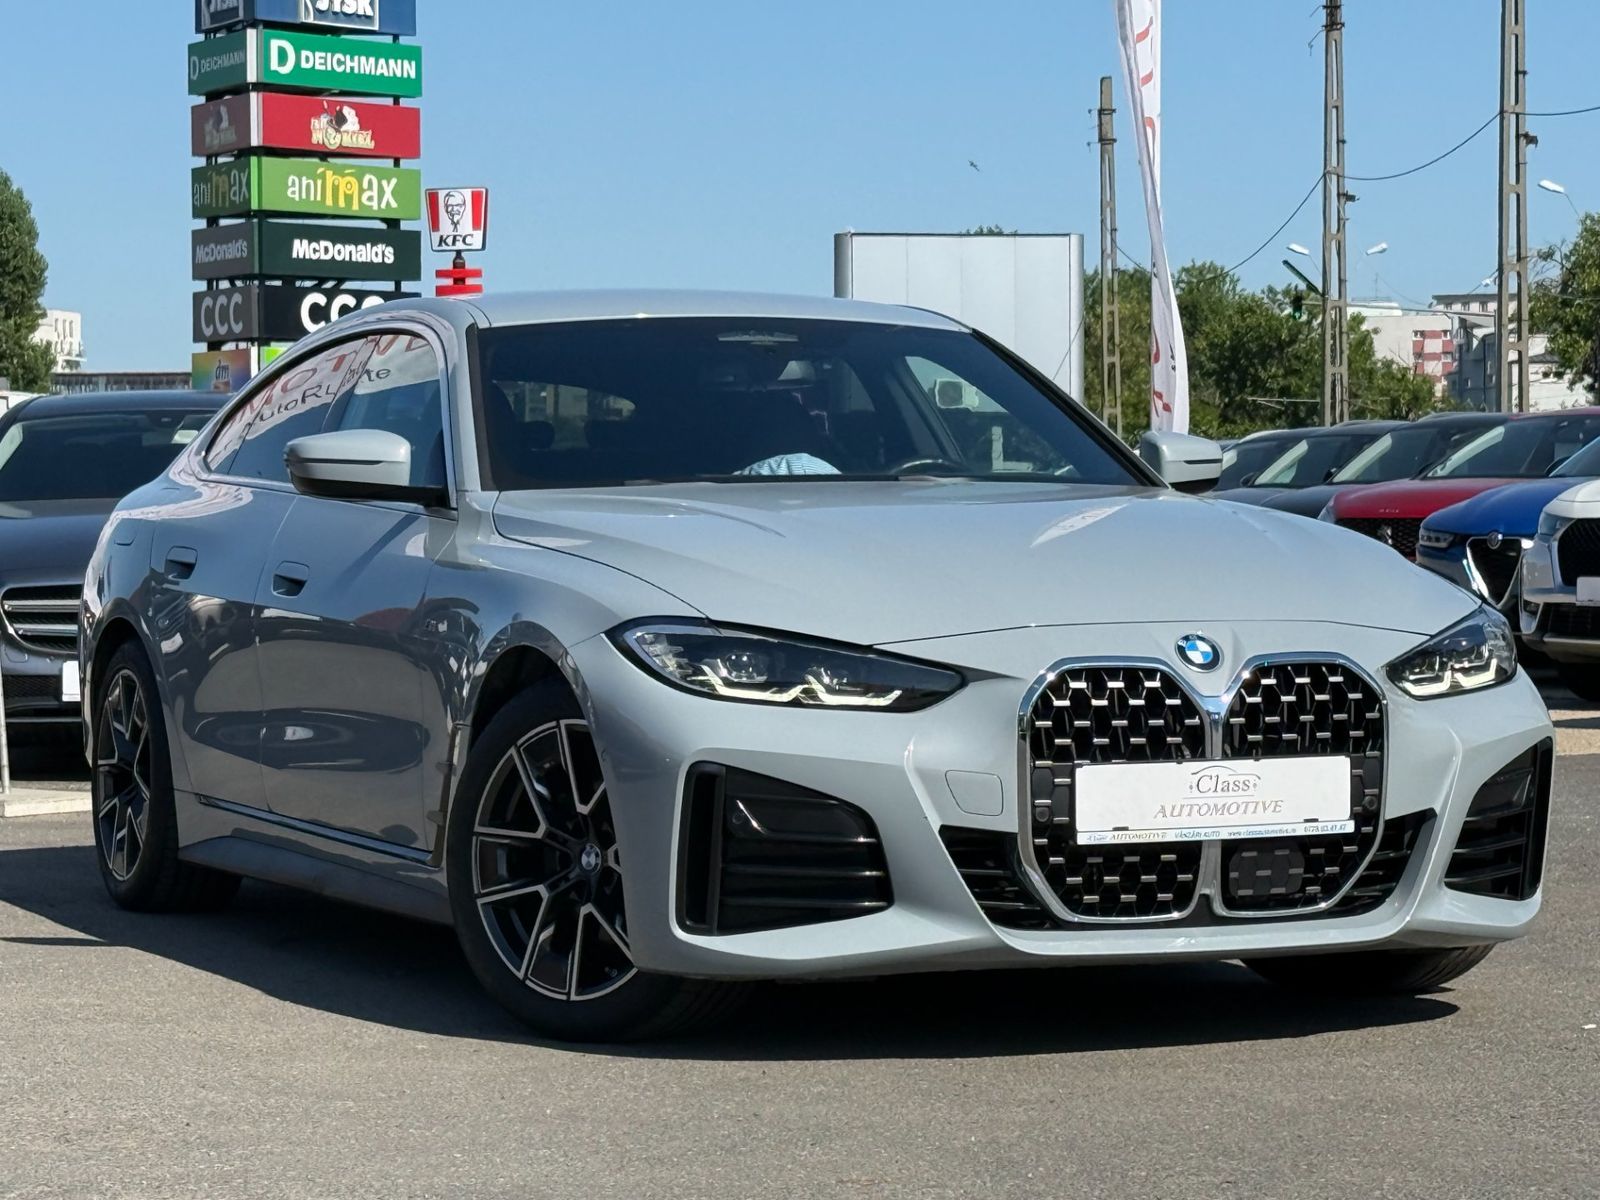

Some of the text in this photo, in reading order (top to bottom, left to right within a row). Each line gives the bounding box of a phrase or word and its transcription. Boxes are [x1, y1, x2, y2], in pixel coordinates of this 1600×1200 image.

[200, 50, 246, 71] DEICHMANN
[301, 50, 416, 79] DEICHMANN
[195, 239, 248, 264] McDonald's
[292, 239, 395, 264] McDonald's
[437, 234, 474, 248] KFC
[200, 292, 243, 337] CCC
[1196, 774, 1250, 794] Class
[1154, 800, 1284, 819] AUTOMOTIVE
